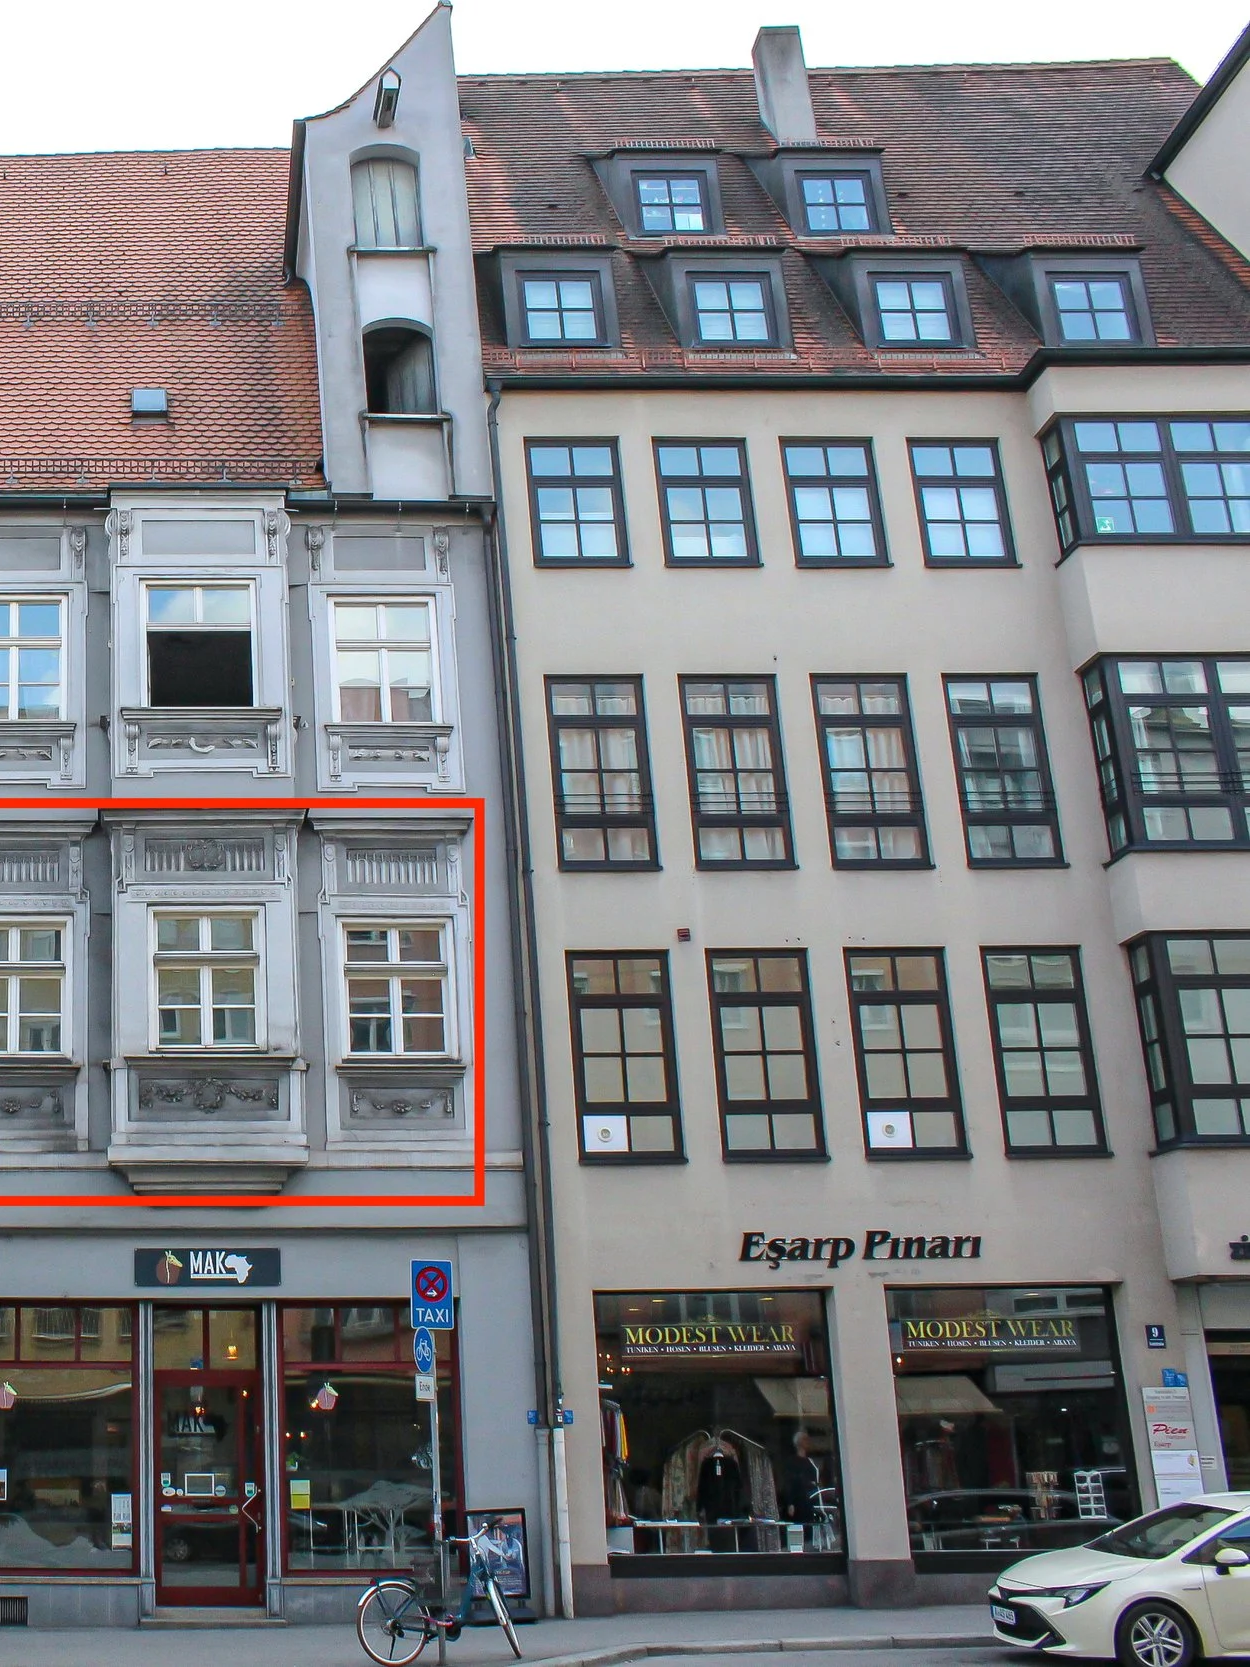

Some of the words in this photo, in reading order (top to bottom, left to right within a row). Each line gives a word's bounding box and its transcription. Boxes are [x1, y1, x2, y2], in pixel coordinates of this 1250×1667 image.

[738, 1230, 856, 1269] Eşarp
[862, 1229, 982, 1259] Pınarı
[190, 1250, 227, 1274] MAK
[415, 1307, 449, 1323] TAXI
[624, 1325, 723, 1345] MODEST
[726, 1324, 795, 1343] WEAR
[905, 1320, 1001, 1338] MODEST
[1006, 1319, 1075, 1337] WEAR
[1151, 1327, 1159, 1337] 9
[626, 1346, 659, 1354] TUNIKEN
